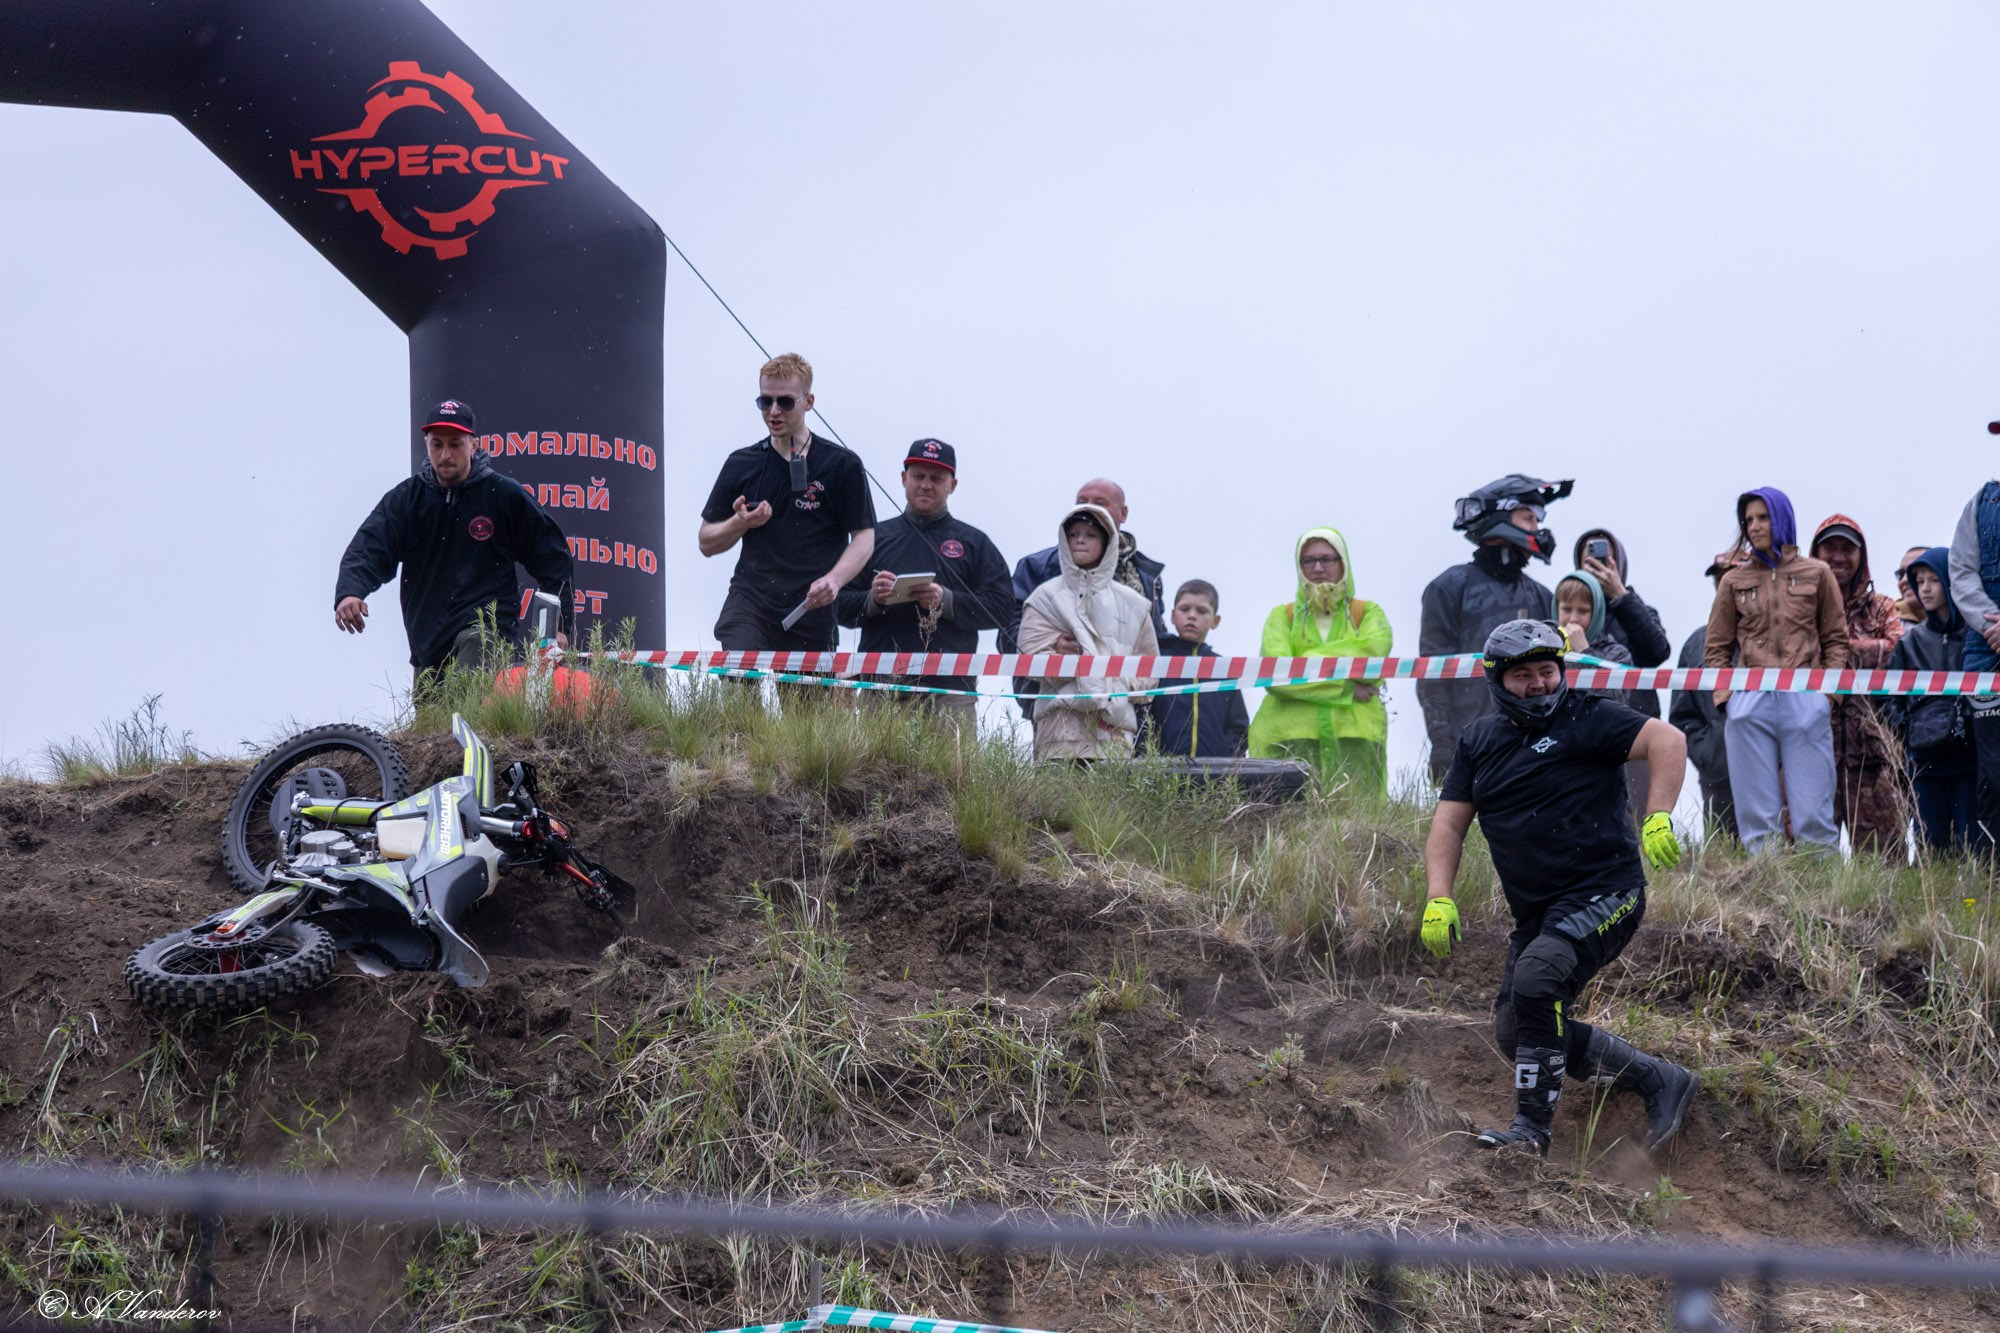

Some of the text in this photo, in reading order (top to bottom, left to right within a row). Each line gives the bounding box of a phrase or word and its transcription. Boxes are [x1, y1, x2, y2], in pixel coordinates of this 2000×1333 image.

[290, 145, 570, 180] HYPERCUT
[480, 431, 657, 471] рмально
[521, 476, 610, 511] лай
[1496, 498, 1520, 511] 10
[1597, 896, 1638, 937] FINNTIL
